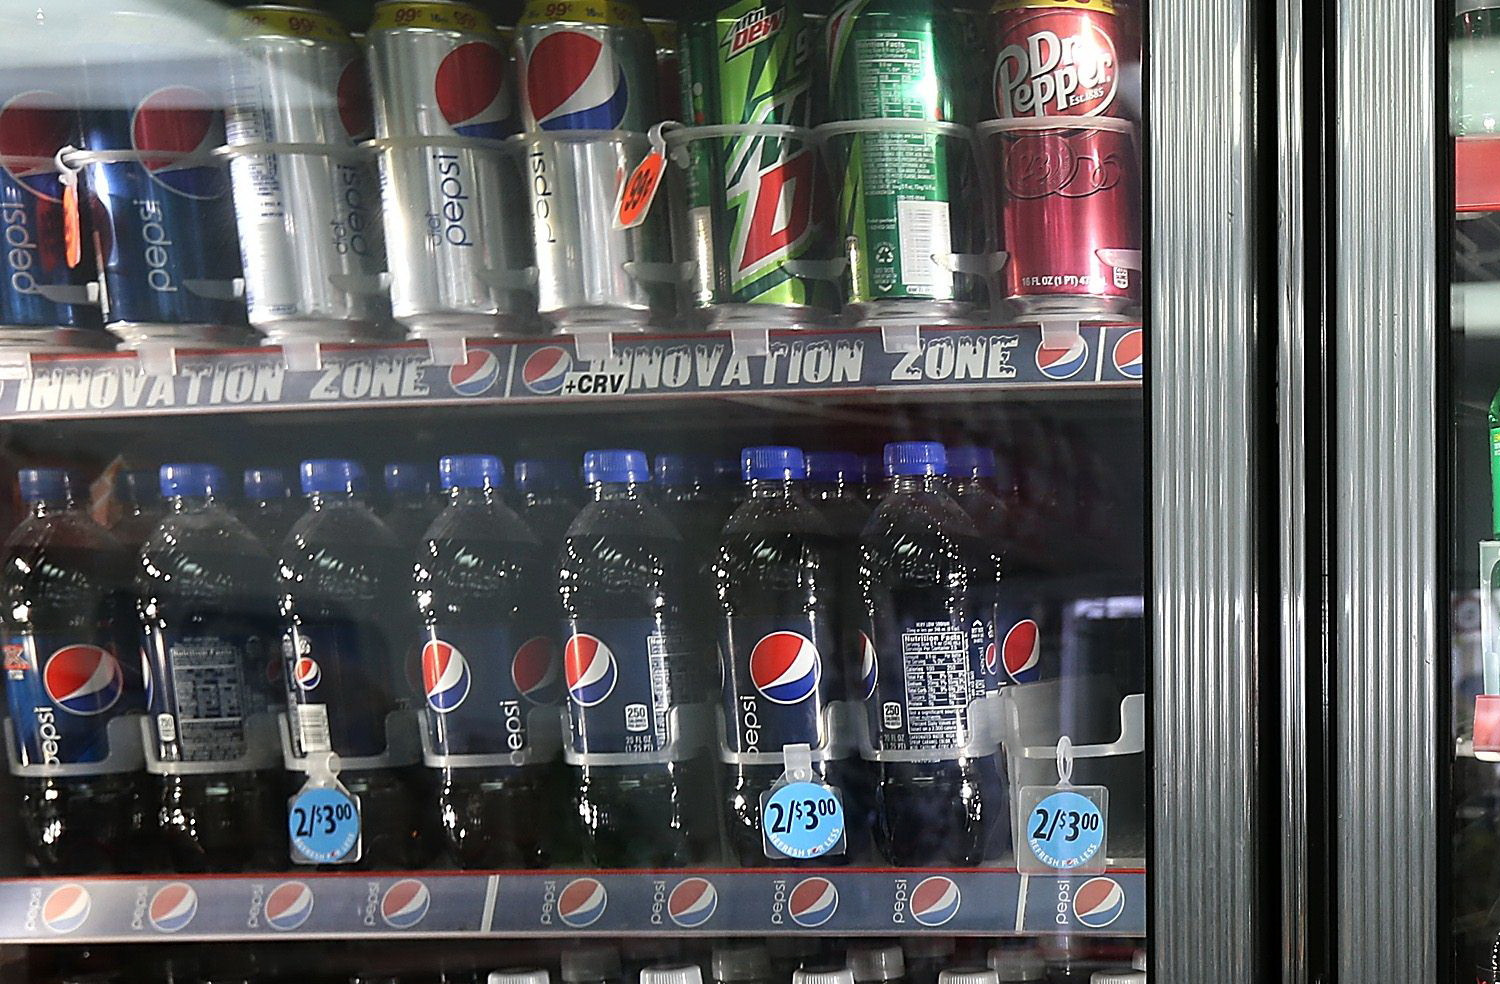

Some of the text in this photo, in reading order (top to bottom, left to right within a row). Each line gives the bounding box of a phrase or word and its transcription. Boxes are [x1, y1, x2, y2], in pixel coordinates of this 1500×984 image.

[433, 153, 473, 247] pepsi
[4, 200, 37, 295] pepsi
[133, 199, 178, 293] pepsi
[891, 335, 1019, 382] ZONE
[16, 356, 432, 412] INNOVATION ZONE
[565, 374, 625, 395] +CRV
[627, 707, 645, 720] 250
[884, 705, 900, 716] 250
[1029, 839, 1060, 867] REFRESH
[1080, 843, 1097, 862] LESS
[248, 883, 264, 929] pepsi
[364, 882, 381, 928] pepsi
[541, 879, 556, 926] pepsi
[651, 879, 666, 926] pepsi
[772, 879, 787, 926] pepsi
[893, 879, 908, 926] pepsi
[1056, 879, 1071, 926] pepsi
